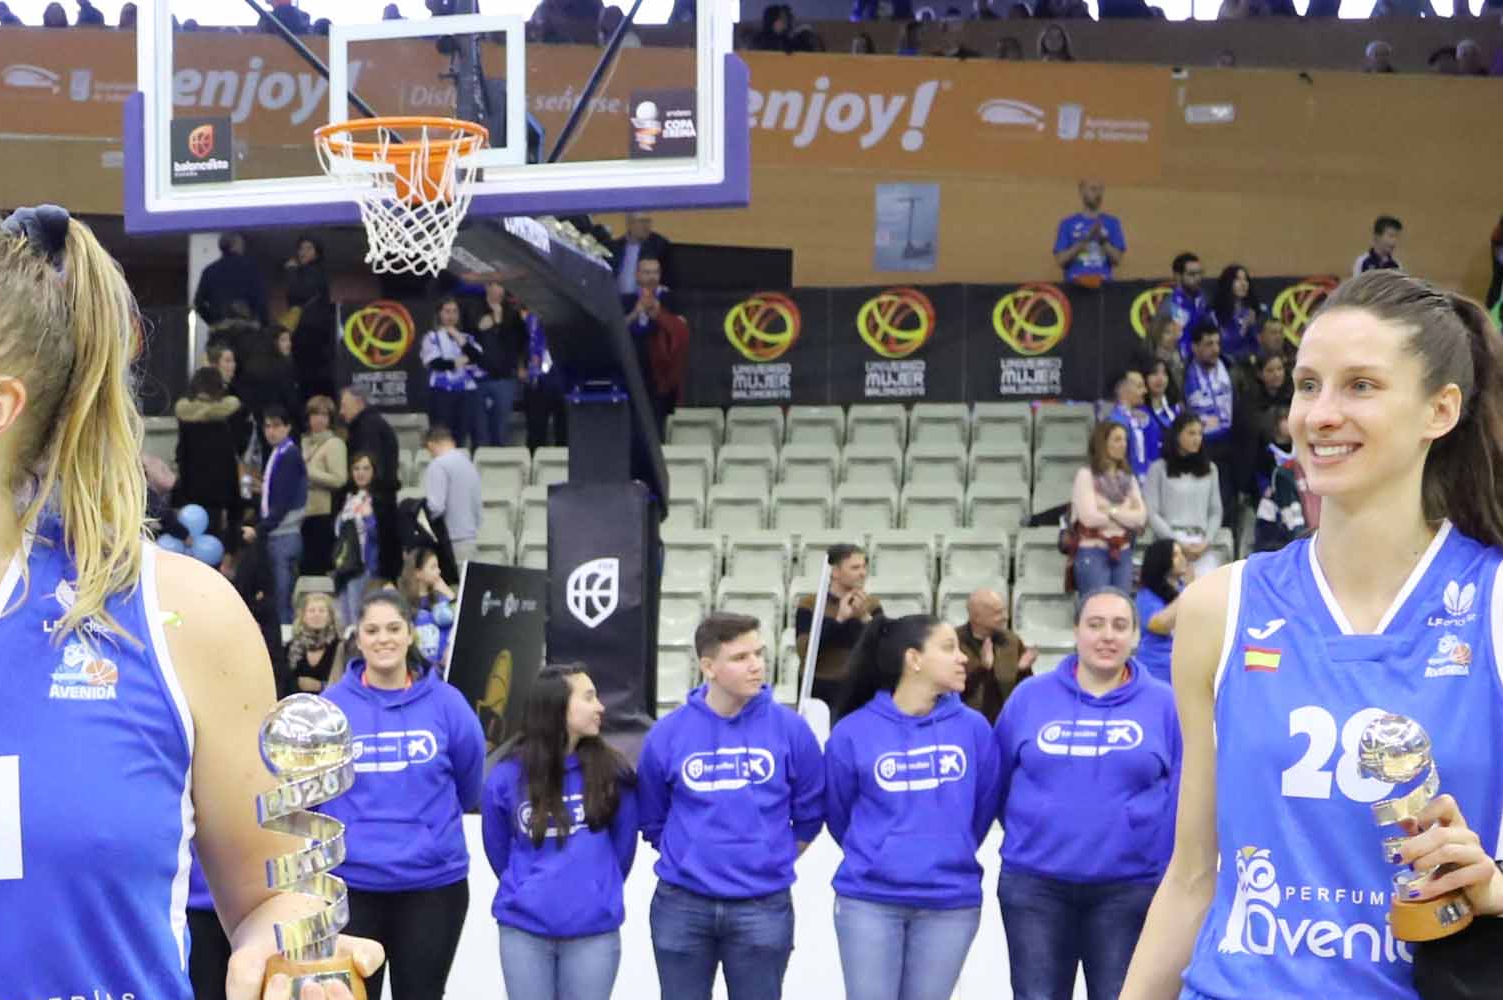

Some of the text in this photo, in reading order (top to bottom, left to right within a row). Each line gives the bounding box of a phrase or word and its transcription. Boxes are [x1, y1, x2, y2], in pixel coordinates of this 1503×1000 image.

[732, 375, 792, 389] MUJER
[866, 373, 925, 387] MUJER
[1001, 370, 1062, 385] MUJER
[49, 684, 118, 699] AVENIDA
[1285, 886, 1396, 906] PERFUM
